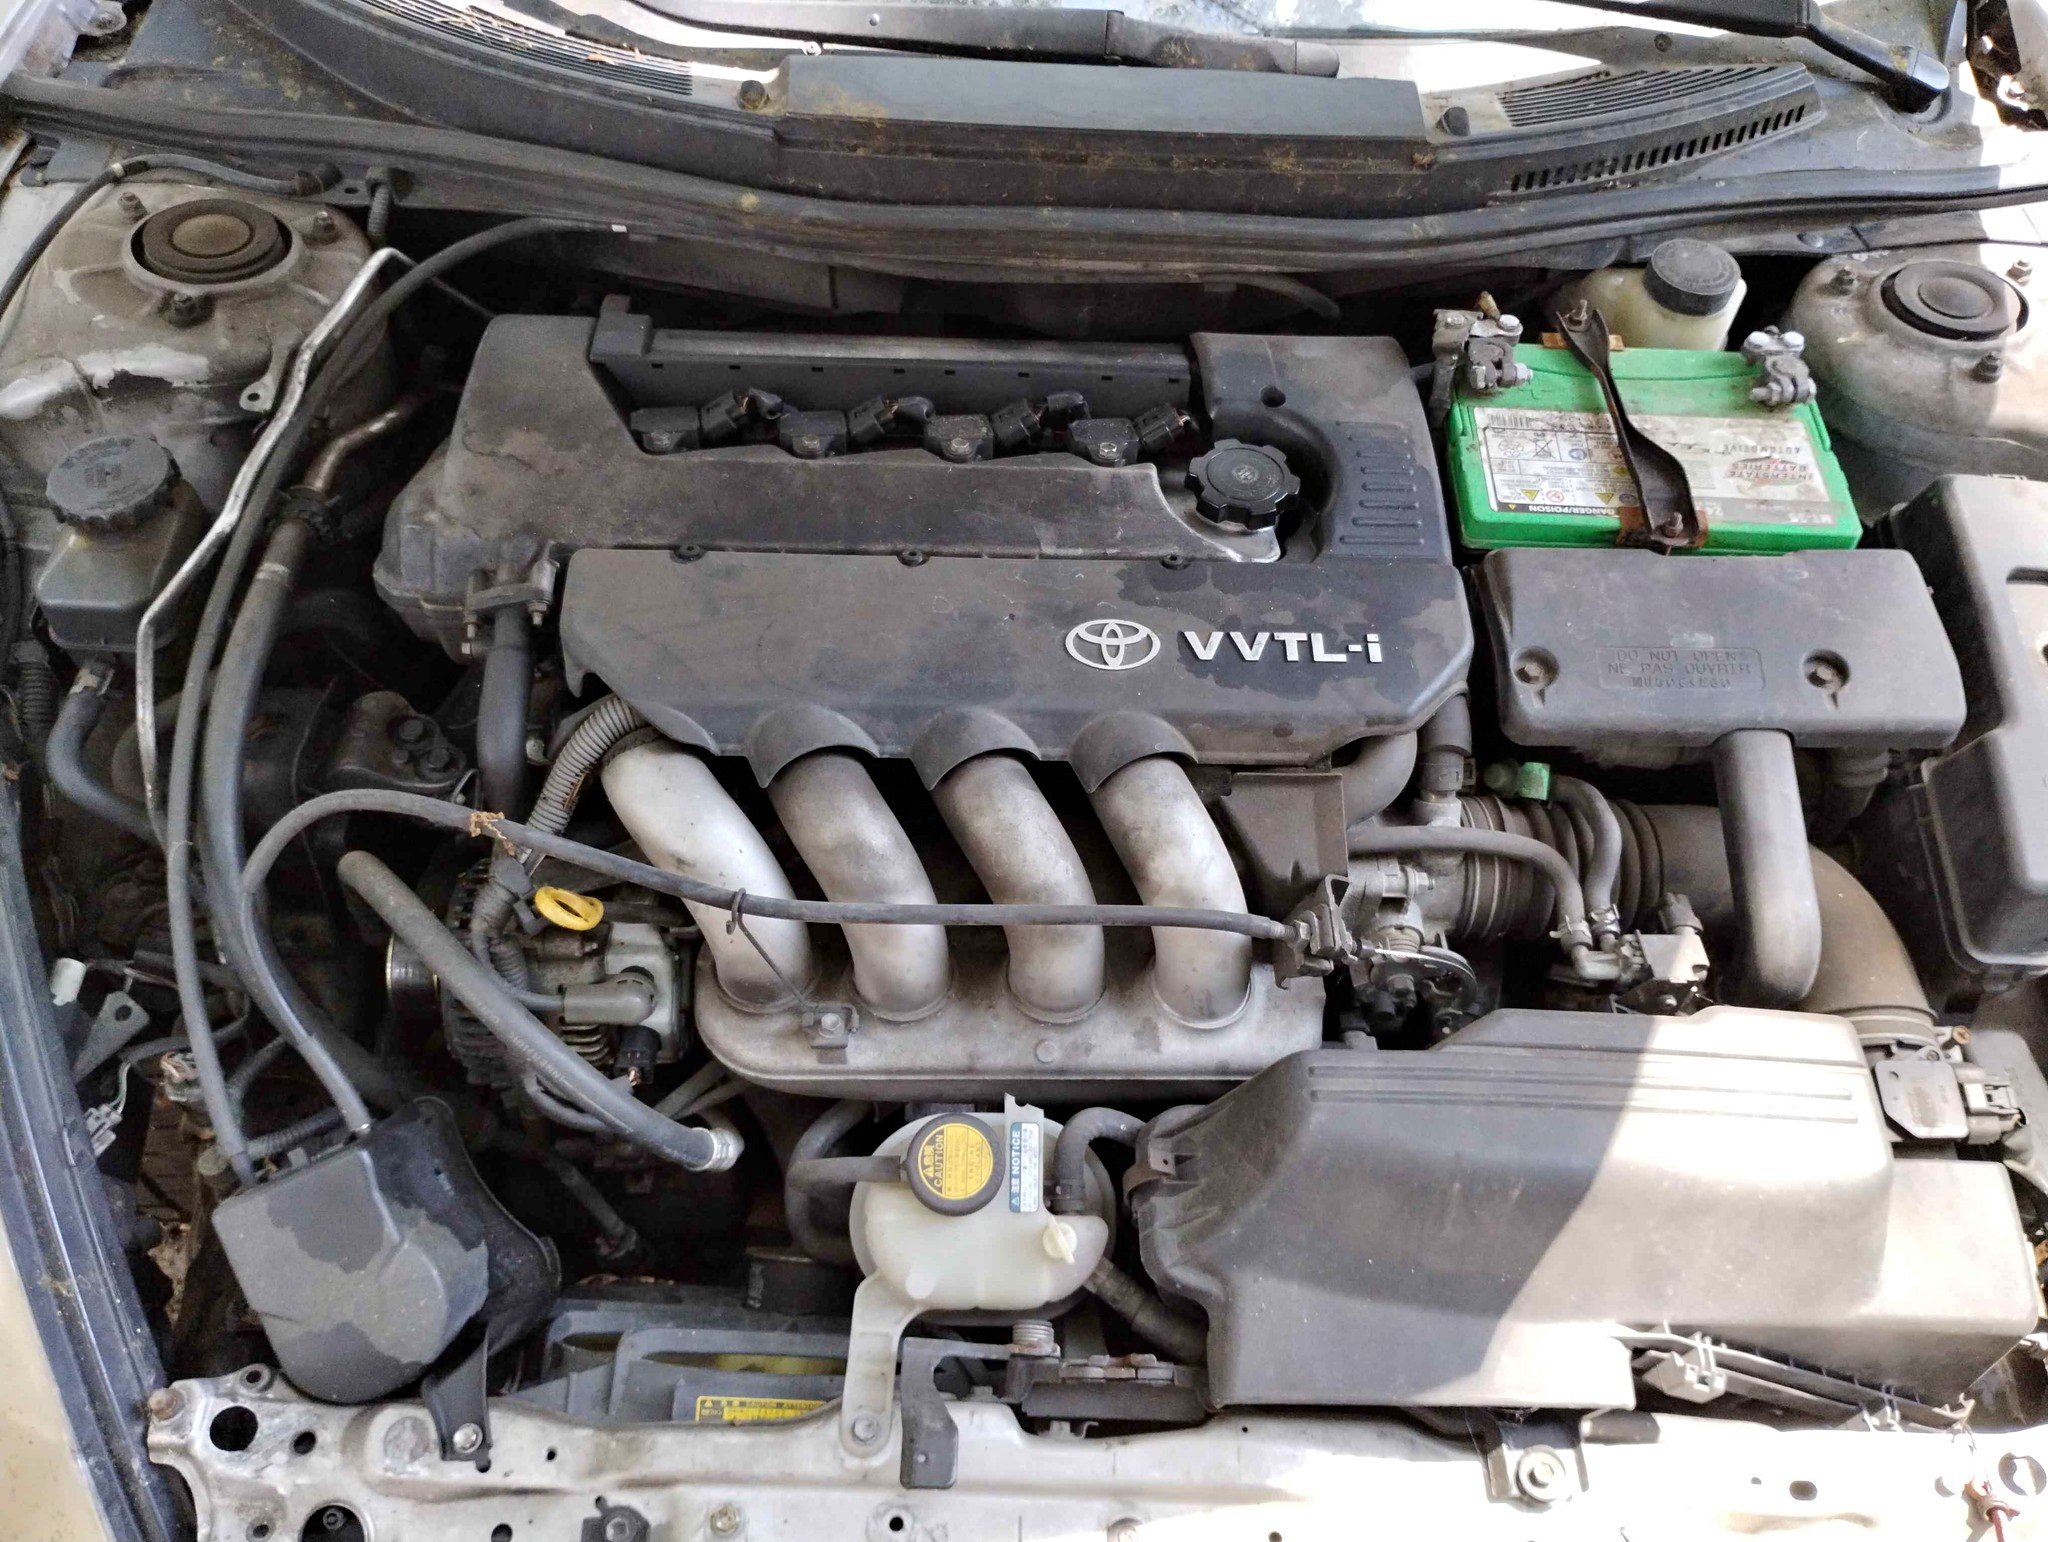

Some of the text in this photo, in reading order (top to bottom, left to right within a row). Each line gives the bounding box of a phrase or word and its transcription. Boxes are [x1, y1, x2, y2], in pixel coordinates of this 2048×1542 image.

[1723, 444, 1800, 454] AUTOMOTIVE
[1731, 463, 1807, 473] BATTERIES
[1729, 470, 1814, 480] INTERSTATE
[1528, 504, 1615, 515] DANGER/POISON
[1184, 631, 1382, 663] VVTL-i
[1617, 650, 1737, 662] DO NOT OPEN
[1641, 663, 1674, 675] PAS
[1685, 663, 1751, 675] OUVRIR
[1012, 1130, 1020, 1173] NOTICE
[934, 1134, 944, 1187] CAUTION
